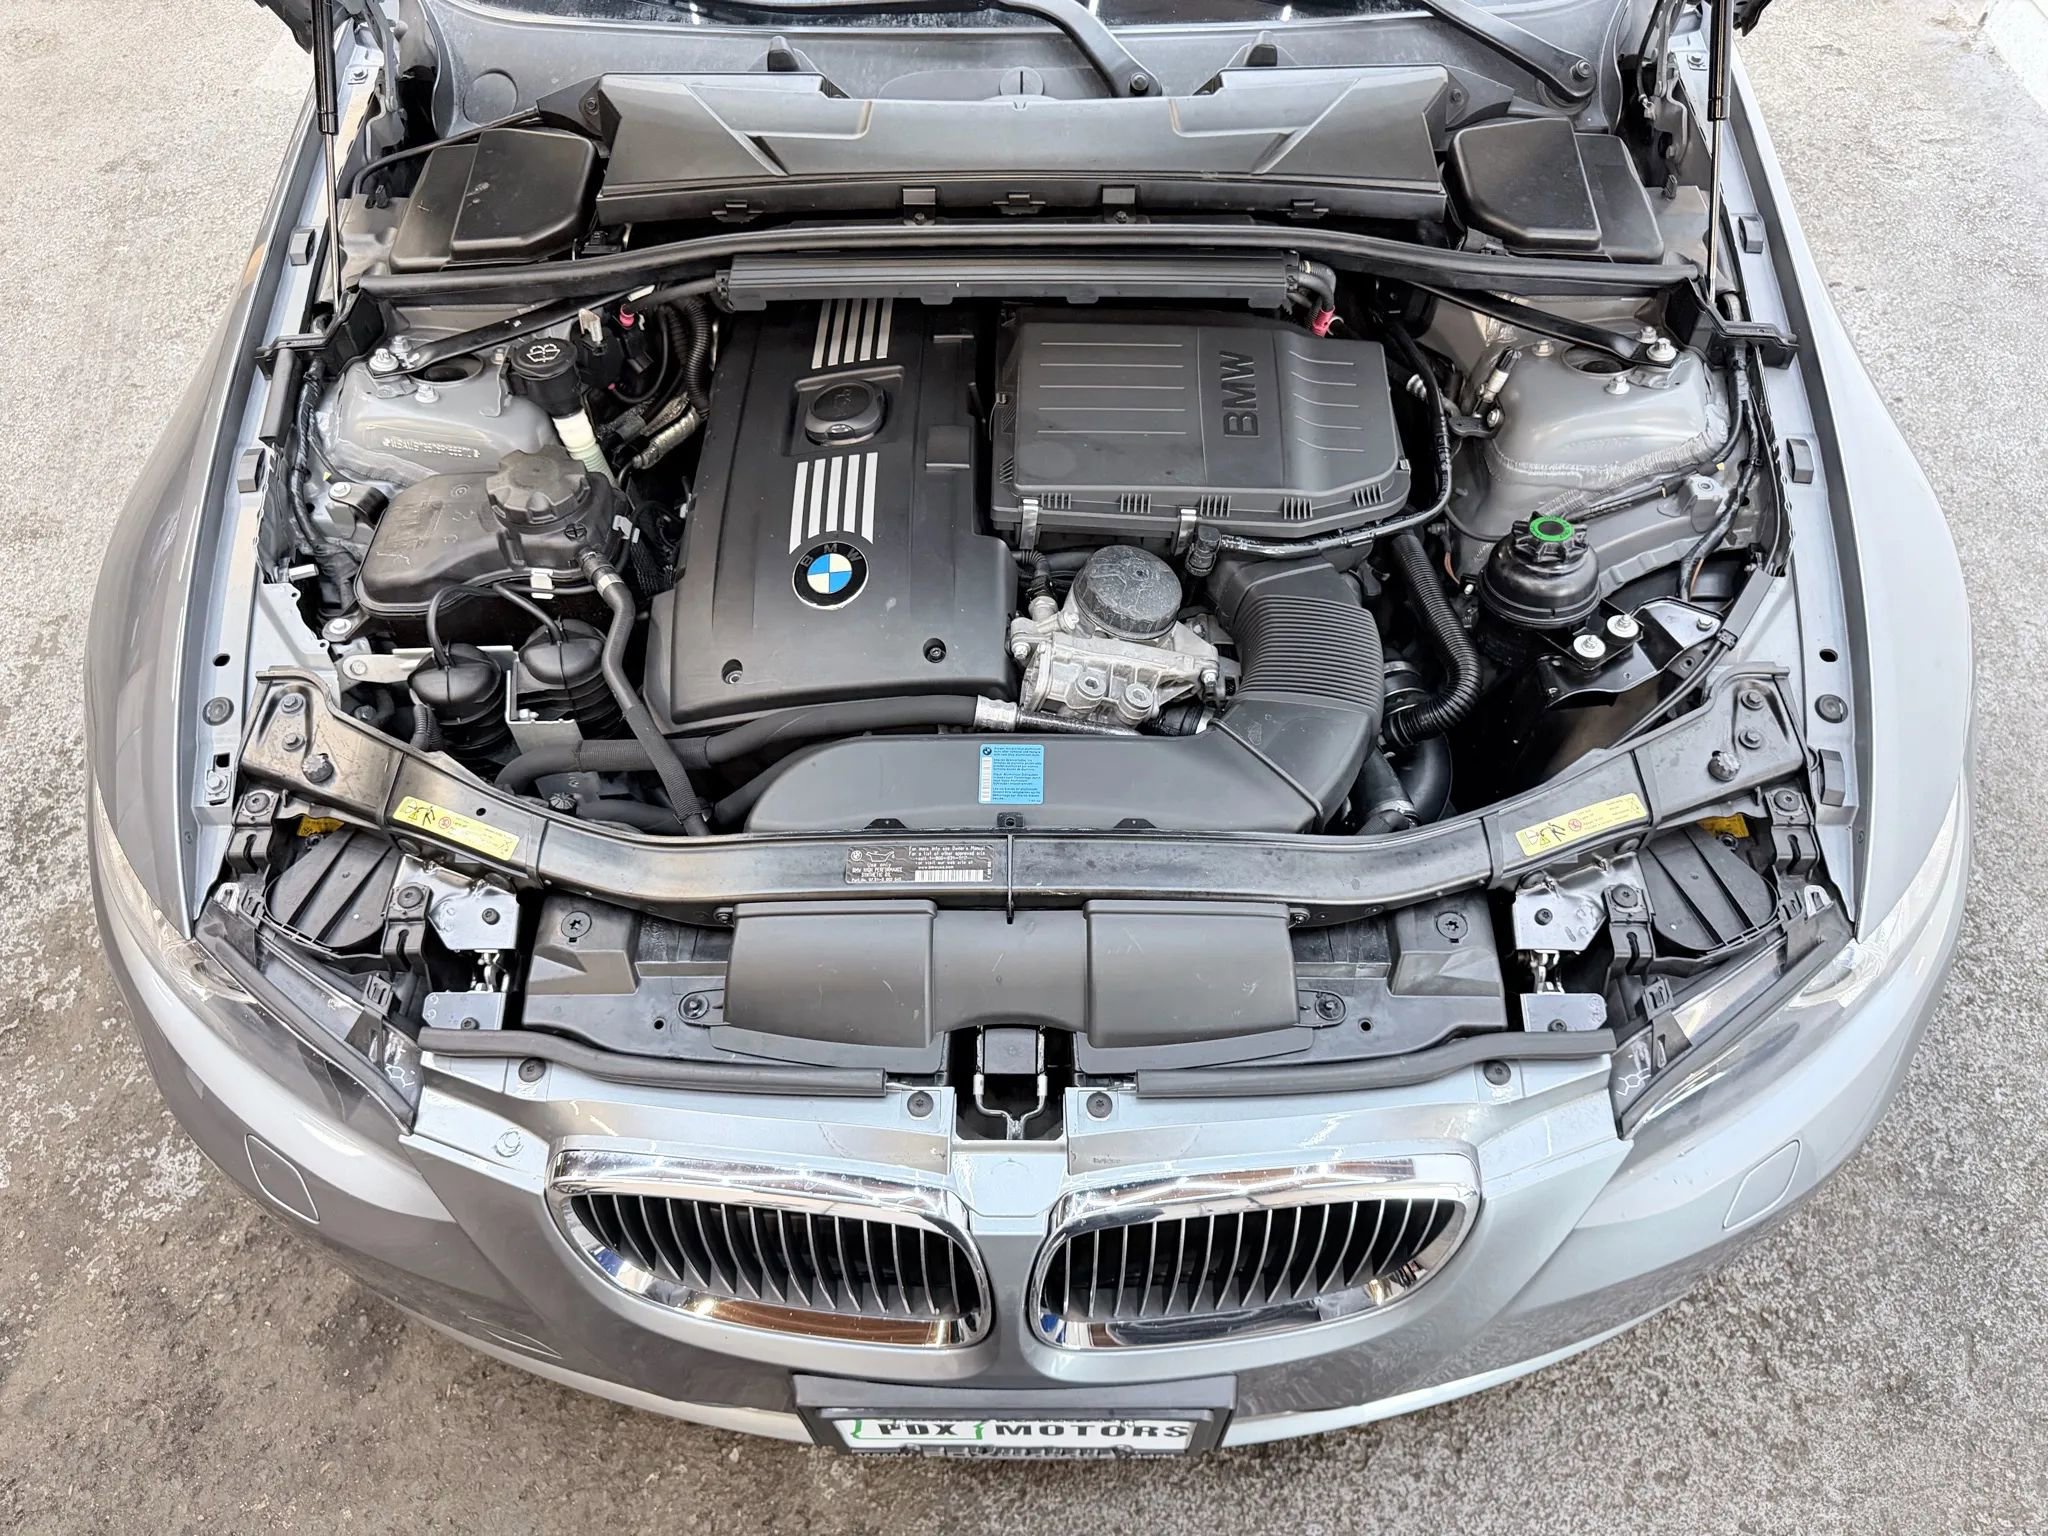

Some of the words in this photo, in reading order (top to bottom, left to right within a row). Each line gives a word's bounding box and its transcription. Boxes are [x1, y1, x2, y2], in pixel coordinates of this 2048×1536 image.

[1219, 351, 1259, 438] BMW
[800, 543, 862, 567] BMW
[878, 1421, 958, 1436] PDX
[995, 1424, 1190, 1438] MOTORS
